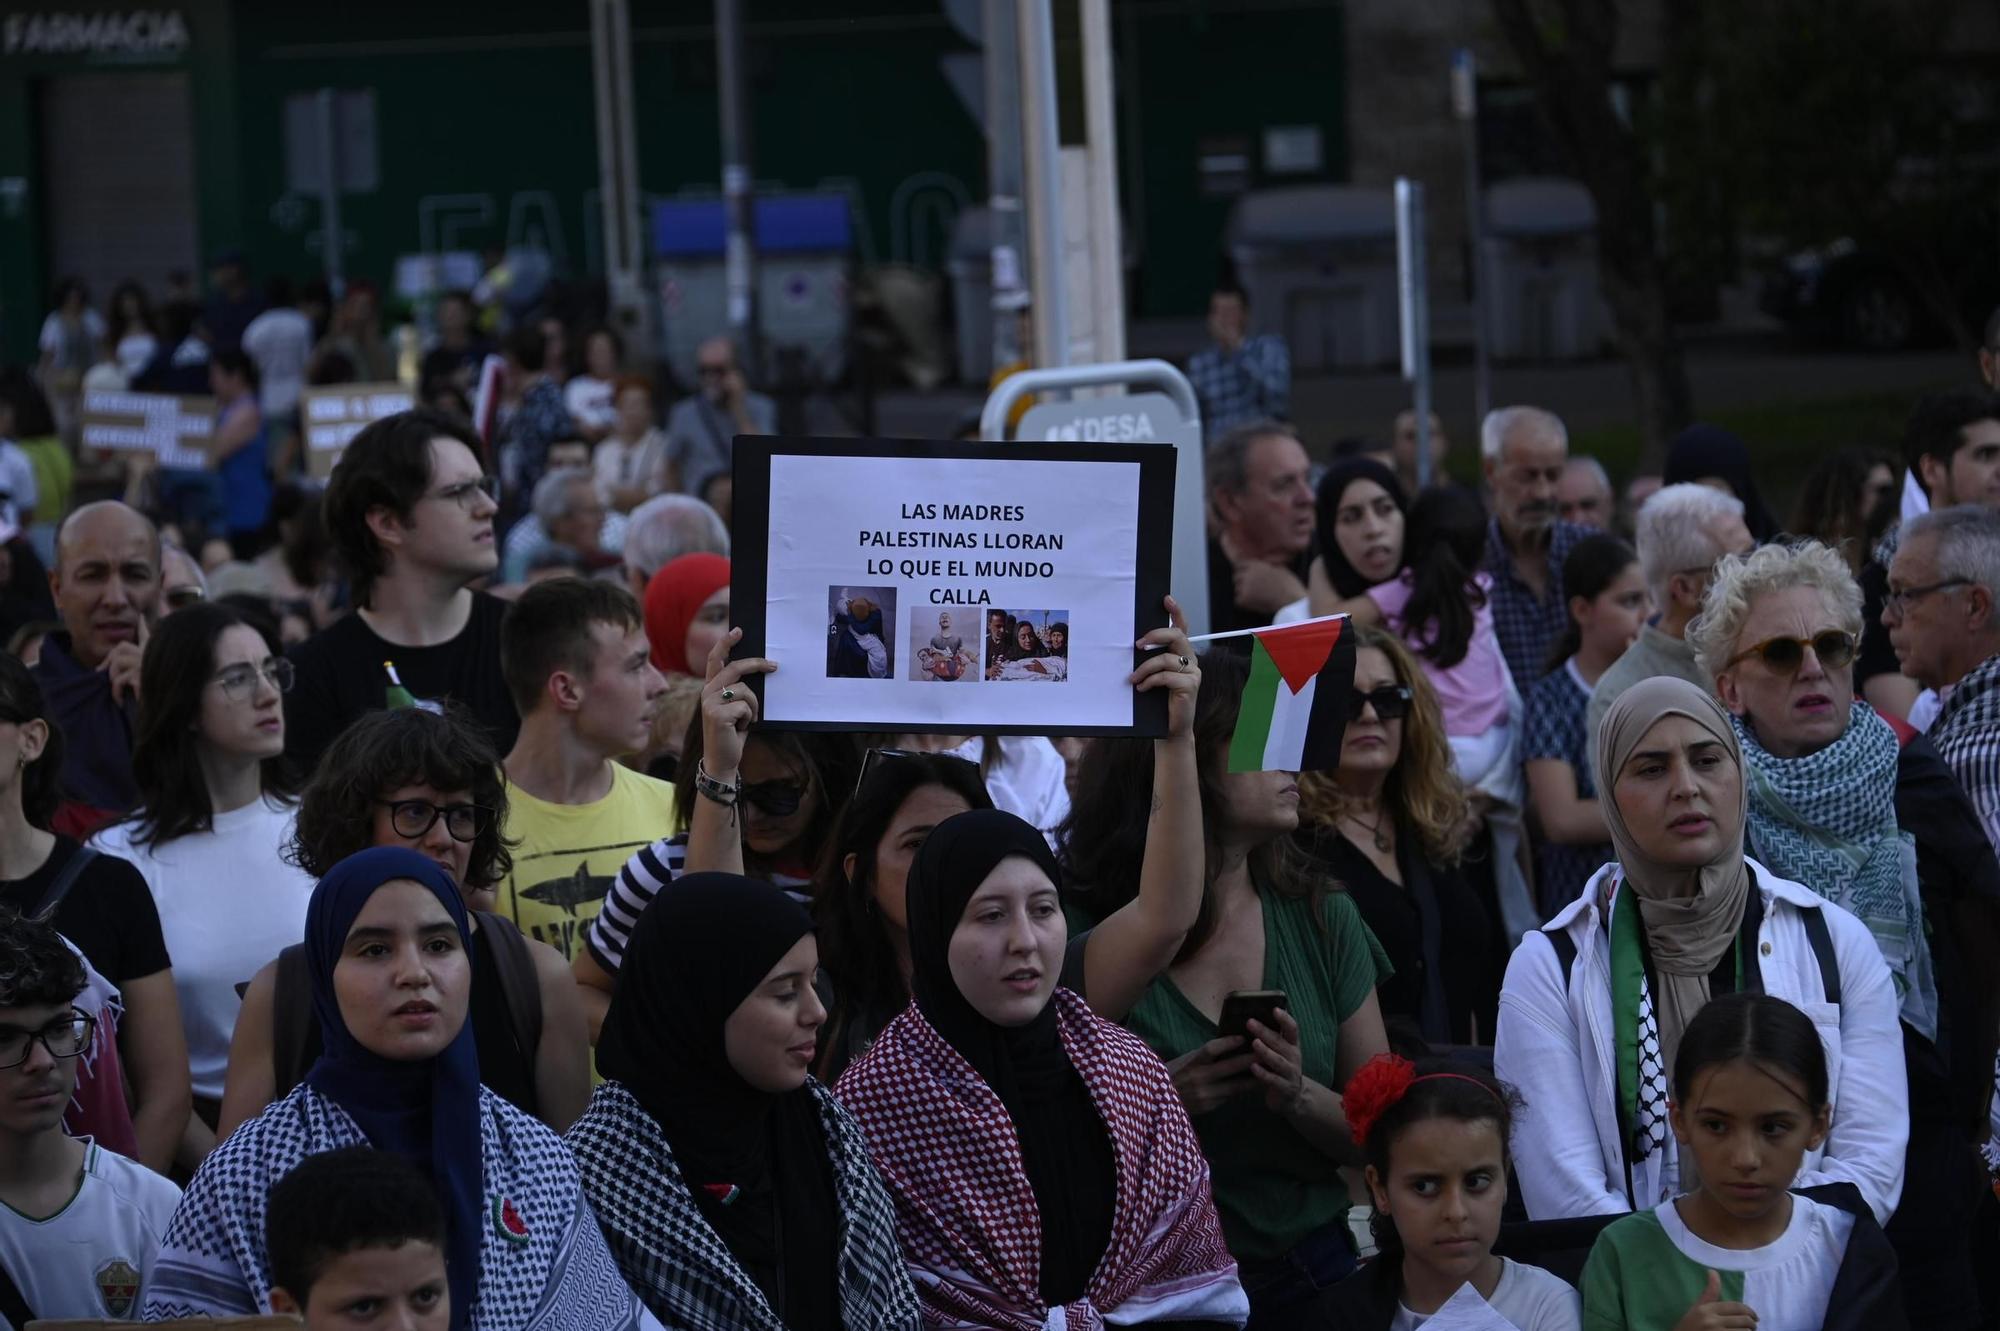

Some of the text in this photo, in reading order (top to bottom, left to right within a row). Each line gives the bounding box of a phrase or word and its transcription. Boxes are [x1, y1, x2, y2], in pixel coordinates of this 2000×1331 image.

[901, 503, 1025, 522] LAS MADRES
[859, 530, 1064, 551] PALESTINAS LLORAN
[867, 558, 1054, 580] LO QUE EL MUNDO
[929, 588, 992, 605] CALLA
